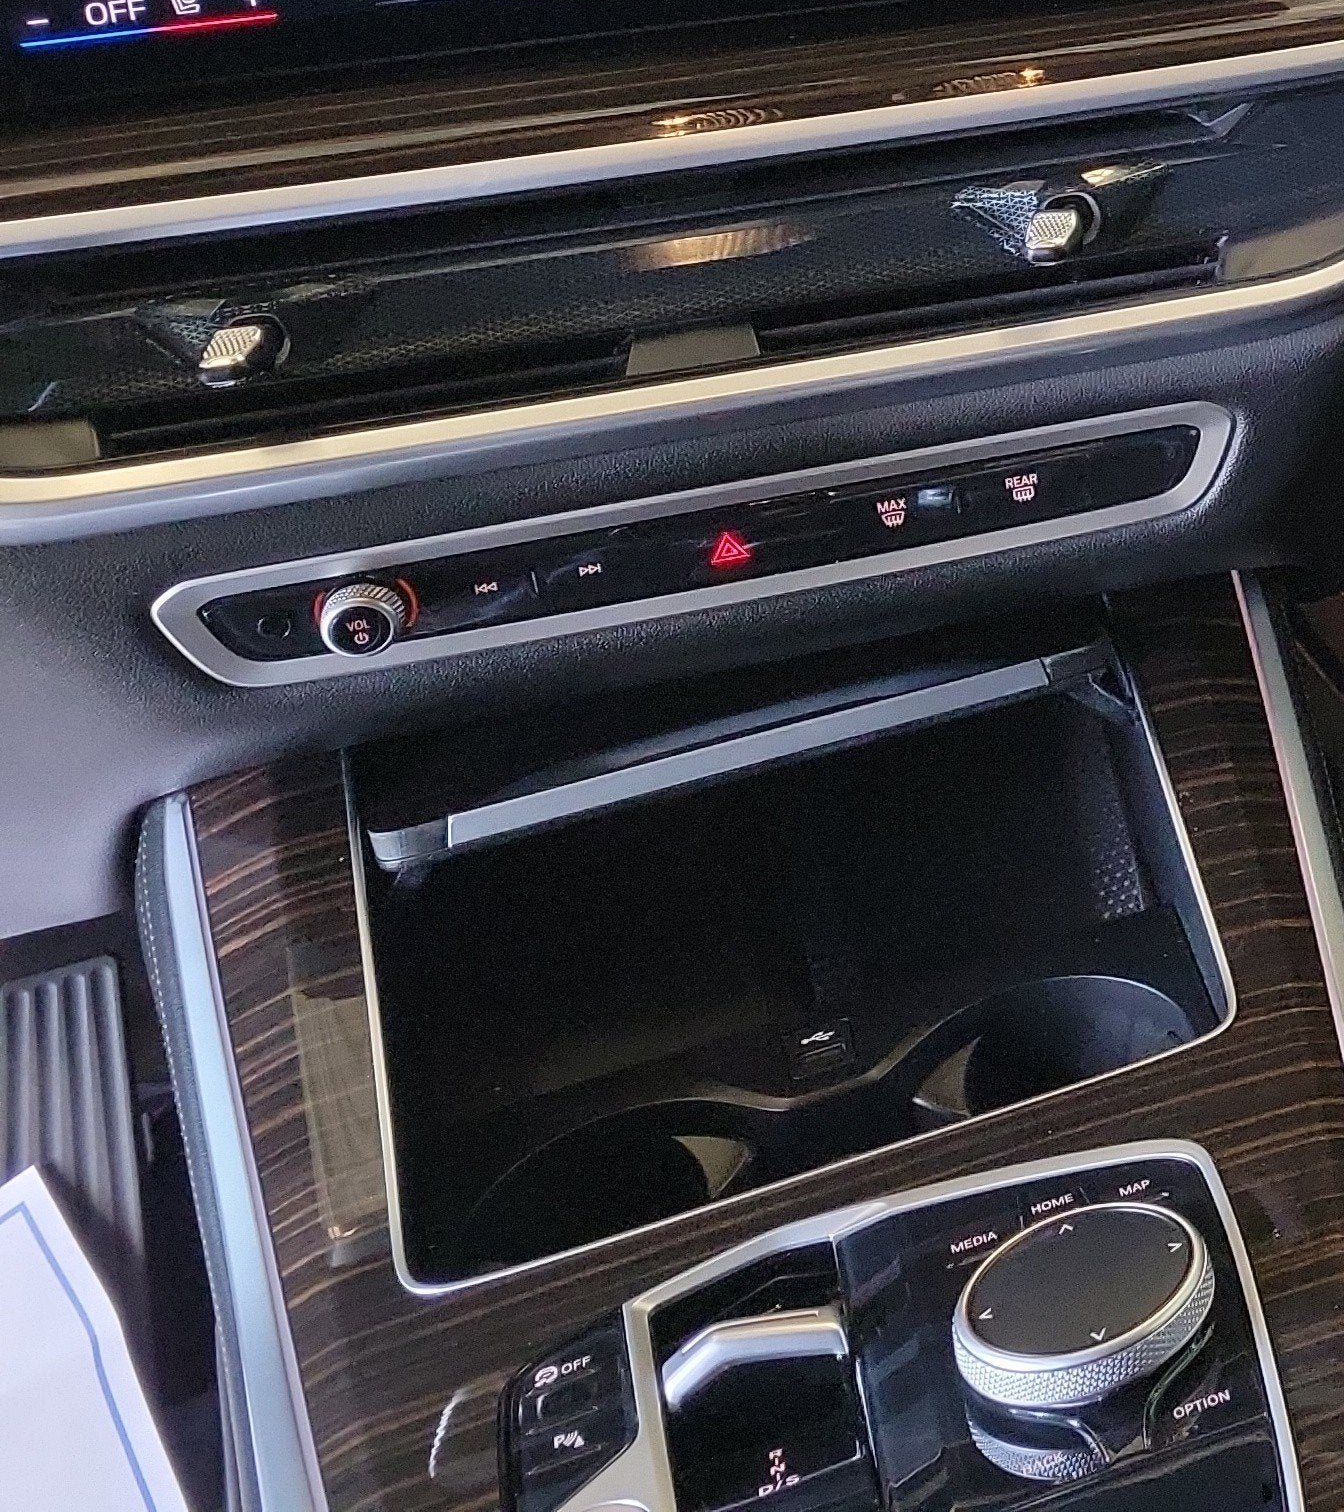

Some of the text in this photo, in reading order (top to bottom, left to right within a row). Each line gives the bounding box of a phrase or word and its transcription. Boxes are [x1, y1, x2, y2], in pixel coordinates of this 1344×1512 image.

[1004, 472, 1039, 489] REAR
[876, 496, 907, 514] MAX
[346, 618, 371, 632] VOL
[1118, 1179, 1151, 1197] MAP
[1030, 1192, 1075, 1216] HOME
[950, 1230, 998, 1255] MEDIA
[561, 1355, 592, 1374] OFF
[1172, 1388, 1231, 1420] OPTION
